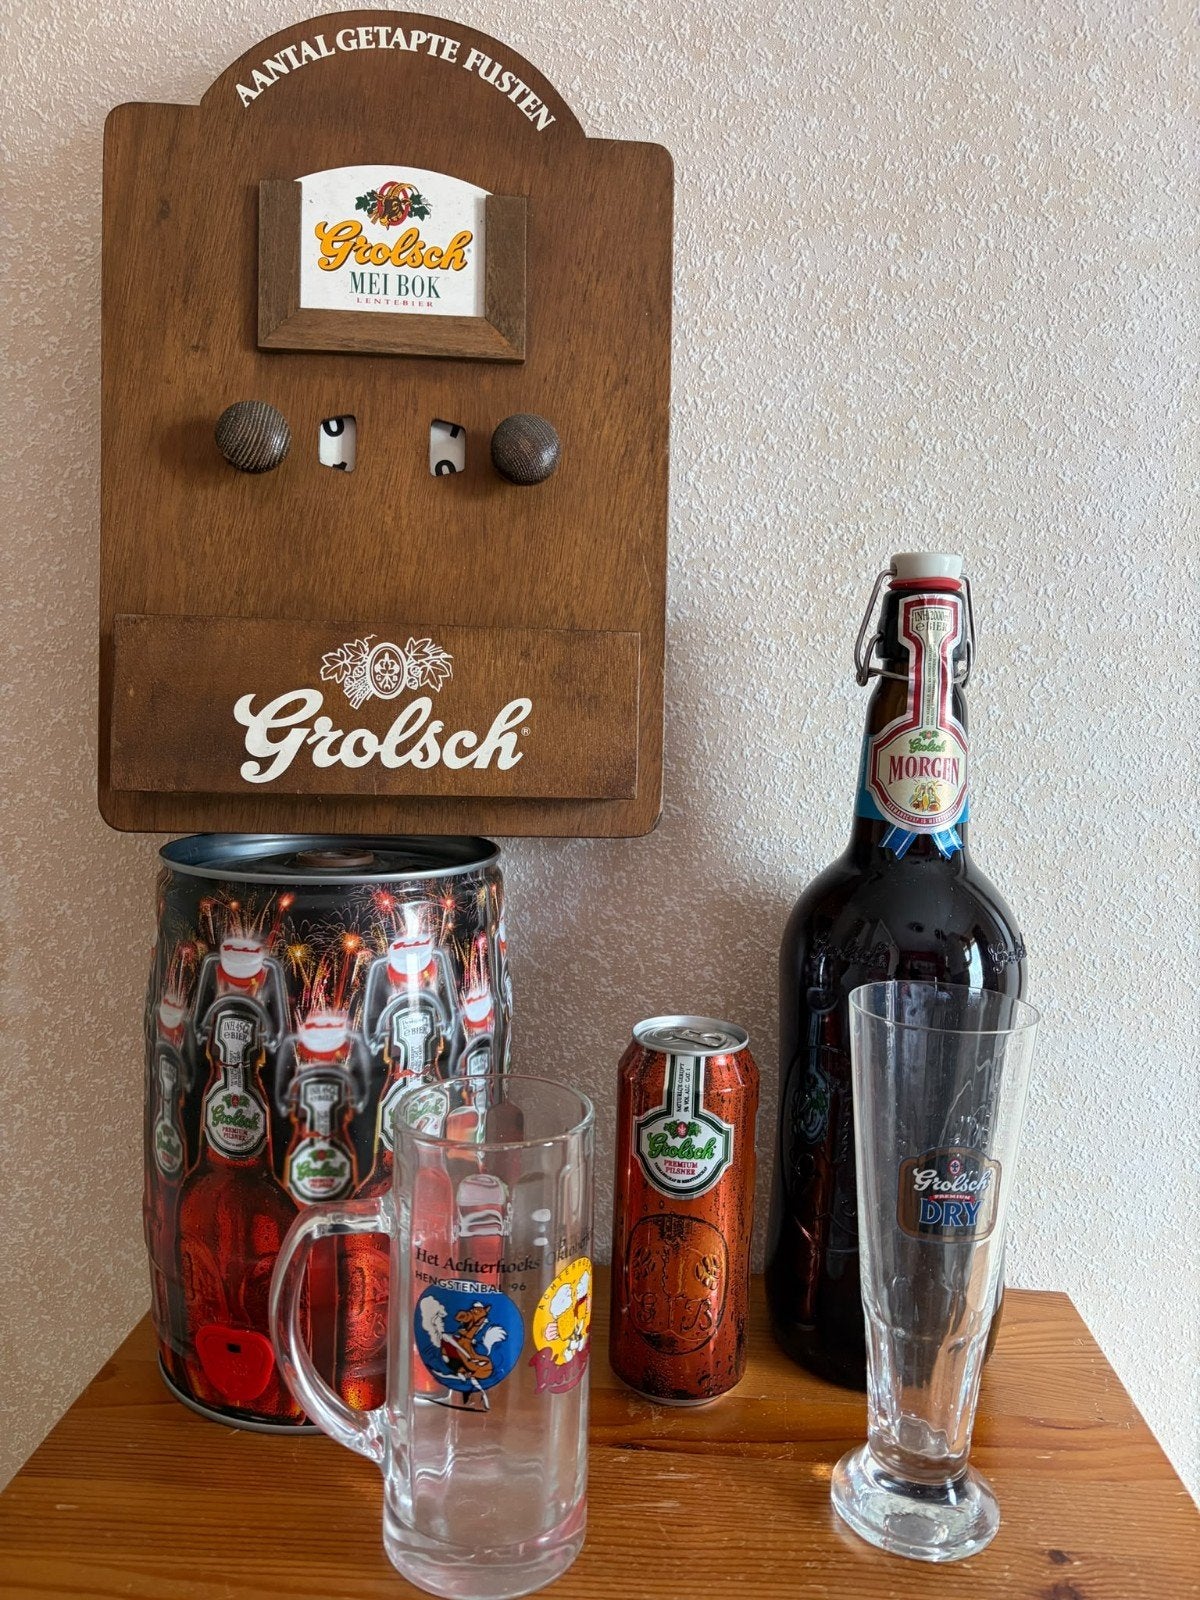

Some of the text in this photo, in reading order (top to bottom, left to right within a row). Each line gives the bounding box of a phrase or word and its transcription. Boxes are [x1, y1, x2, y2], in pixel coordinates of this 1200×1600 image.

[235, 26, 556, 131] AANTAL GETAPTE FUSTEN
[315, 220, 473, 271] Grolsch
[349, 271, 441, 299] MEI BOK
[357, 297, 433, 308] LENTEBIER
[233, 688, 533, 784] Grolsch
[908, 738, 947, 753] Grolsch
[888, 755, 960, 788] MORGEN
[647, 1132, 717, 1160] Grolsch
[664, 1160, 698, 1169] PREMIUM
[665, 1167, 696, 1176] PILSNER
[912, 1167, 991, 1192] Grolsch
[918, 1197, 985, 1227] DRY
[415, 1247, 440, 1266] Het
[443, 1254, 542, 1274] Achterhoeks
[415, 1270, 503, 1294] HENGSTENBAL
